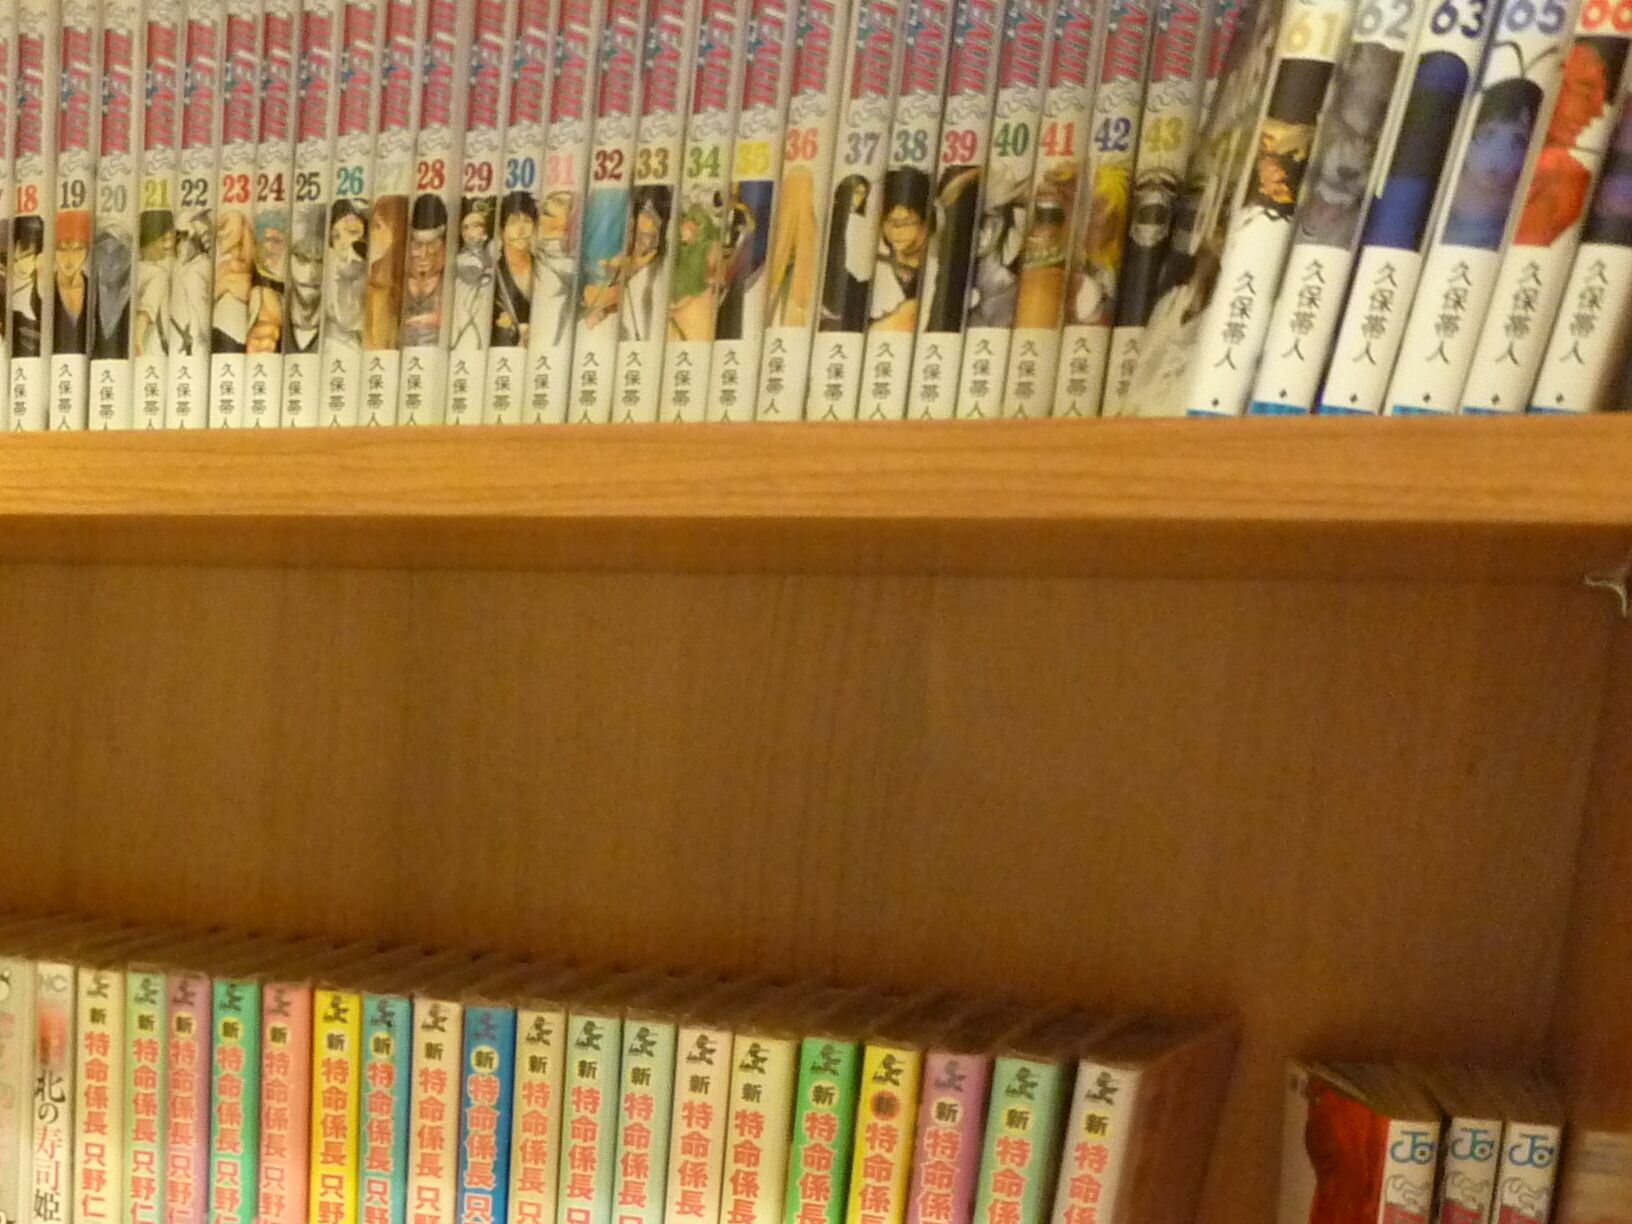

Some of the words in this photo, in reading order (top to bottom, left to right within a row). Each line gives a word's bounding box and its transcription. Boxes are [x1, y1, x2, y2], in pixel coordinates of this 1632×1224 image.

[786, 128, 818, 161] 36
[846, 132, 880, 164] 37
[894, 129, 928, 161] 38
[994, 123, 1029, 155] 40
[1040, 122, 1075, 156] 41
[1095, 118, 1131, 151] 42
[417, 159, 445, 189] 28
[506, 157, 535, 188] 30
[594, 149, 623, 180] 32
[688, 146, 720, 178] 34
[61, 180, 85, 208] 19
[180, 179, 208, 207] 22
[223, 173, 251, 202] 23
[257, 173, 285, 201] 24
[295, 172, 322, 200] 25
[336, 167, 365, 196] 26
[15, 184, 39, 213] 18
[34, 1071, 65, 1222] 北の寿司姫
